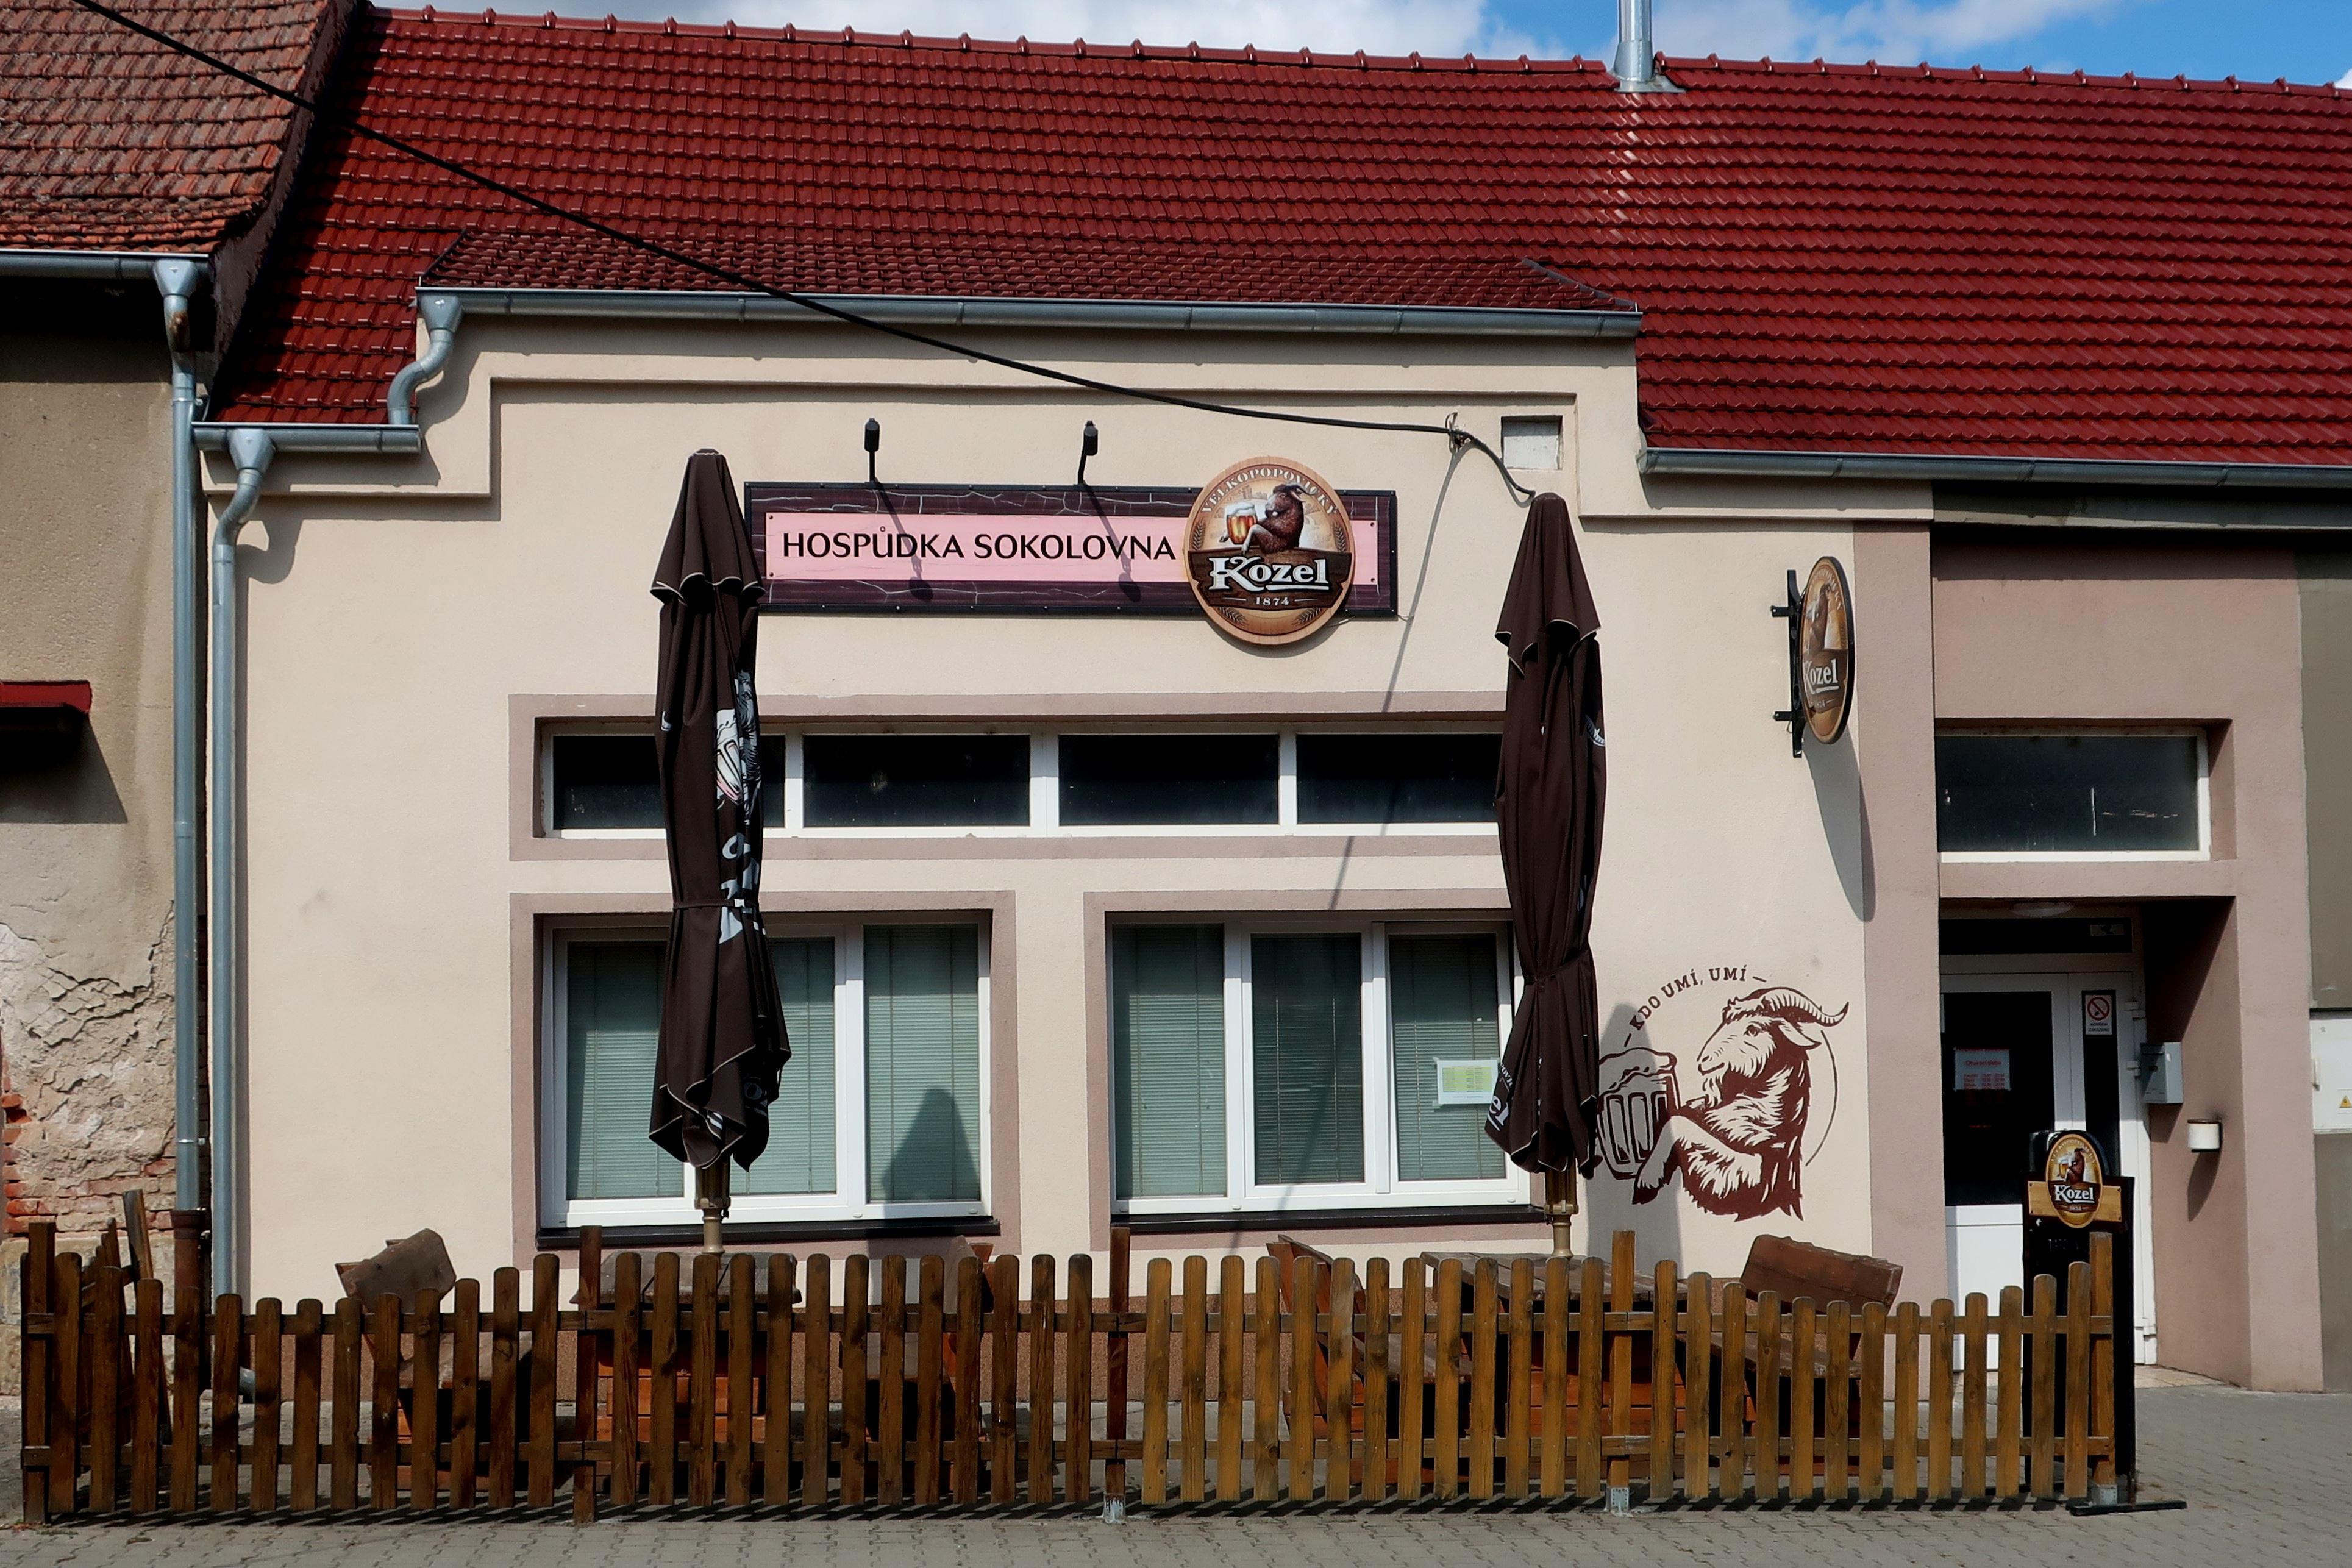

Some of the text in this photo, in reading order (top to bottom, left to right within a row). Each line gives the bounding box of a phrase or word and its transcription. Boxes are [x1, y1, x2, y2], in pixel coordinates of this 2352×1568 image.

[783, 526, 1177, 561] HOSPŮDKA SOKOLOVNA
[1208, 556, 1330, 591] Kozel
[1255, 596, 1290, 606] 1874
[1803, 658, 1839, 695] Kozel
[1629, 964, 1748, 1031] KDO UMÍ, UMÍ
[2053, 1185, 2095, 1203] Kozel
